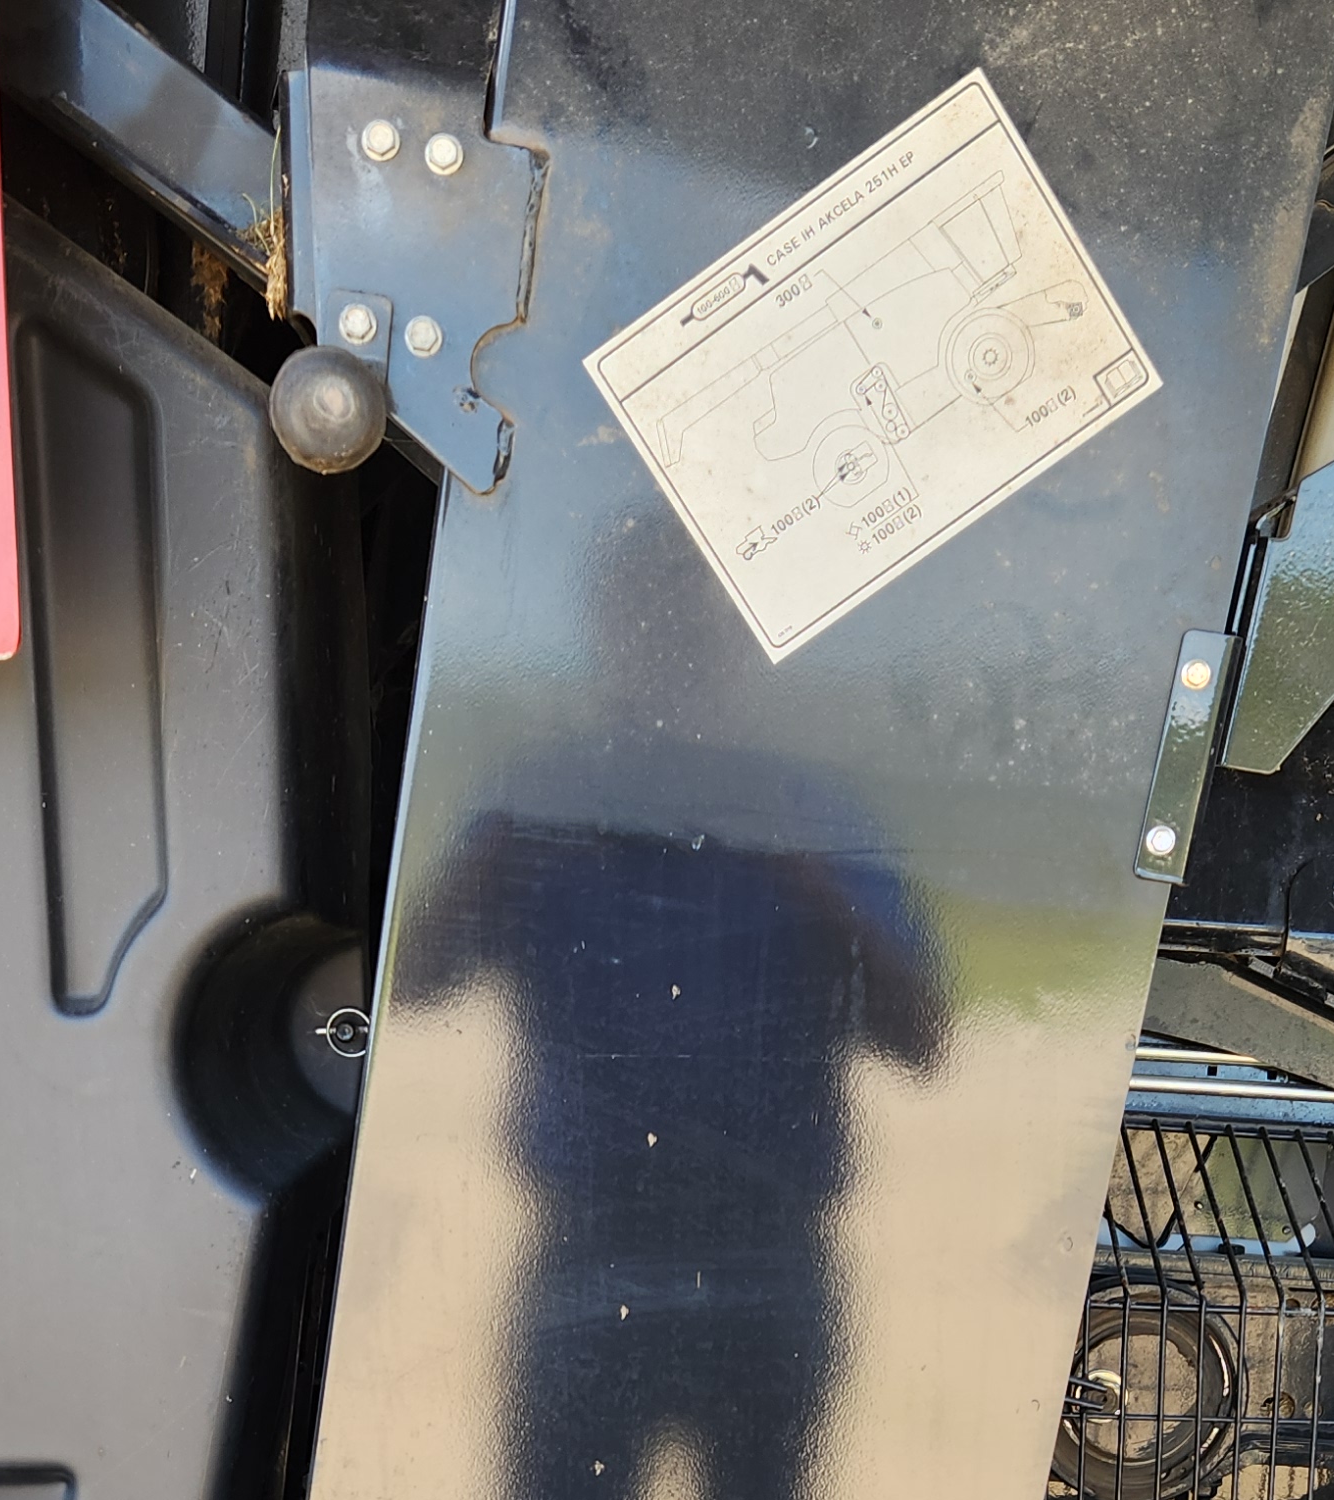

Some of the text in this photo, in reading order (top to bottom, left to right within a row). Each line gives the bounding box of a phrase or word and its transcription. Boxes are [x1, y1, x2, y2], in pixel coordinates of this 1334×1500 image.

[766, 150, 914, 266] CASE IH AKCELA 251H EP
